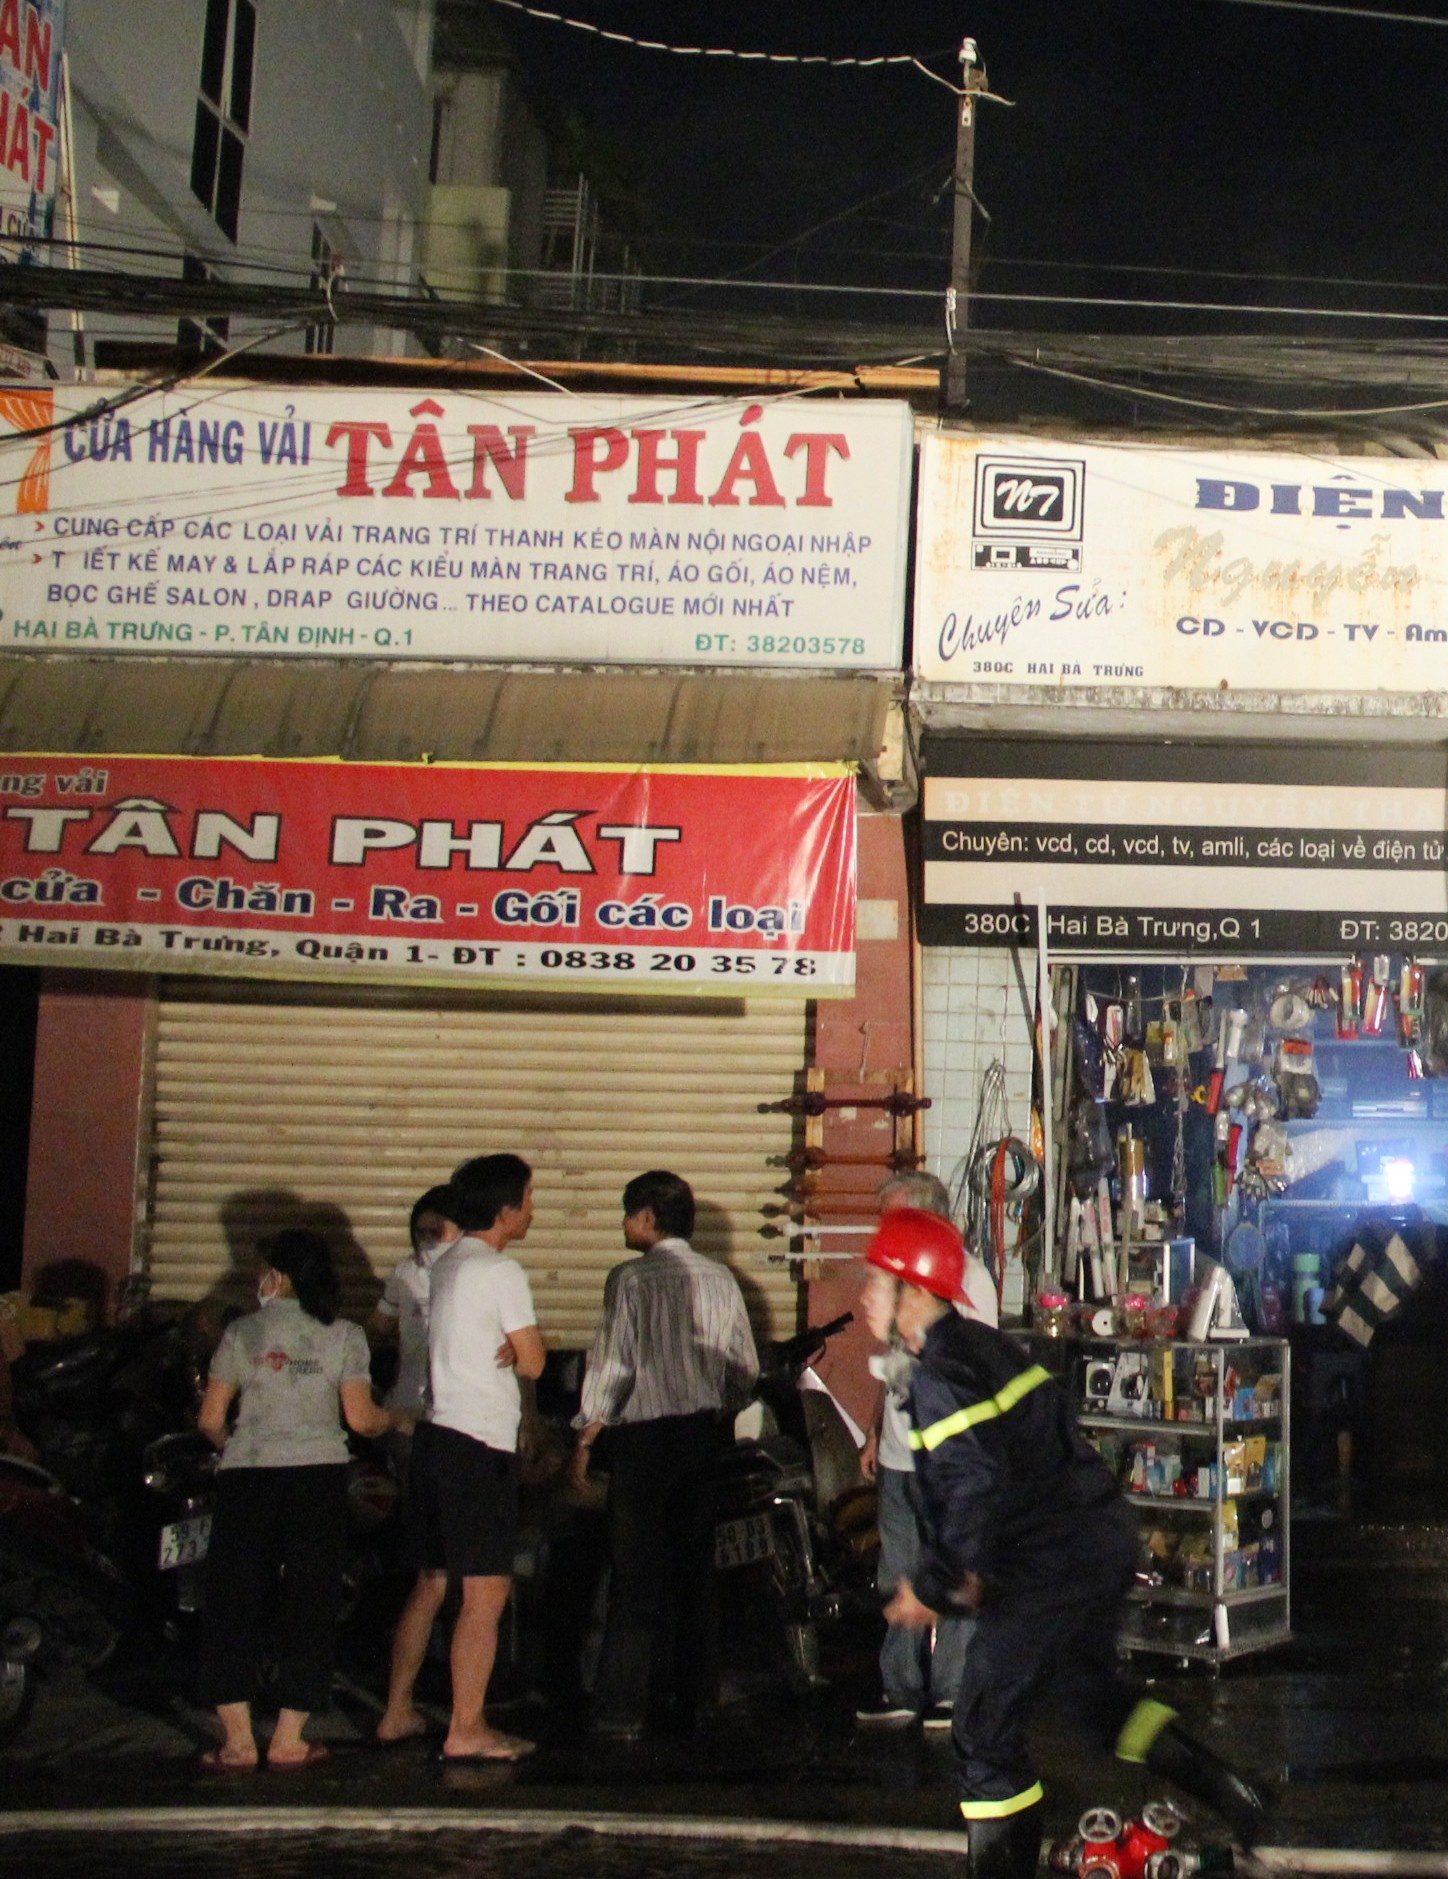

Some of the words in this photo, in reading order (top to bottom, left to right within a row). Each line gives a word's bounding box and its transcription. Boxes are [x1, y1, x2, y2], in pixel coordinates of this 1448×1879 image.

[0, 86, 54, 194] ÁT
[64, 408, 132, 463] CỬA
[148, 408, 246, 466] HÀNG
[259, 404, 311, 466] VẢI
[325, 398, 536, 501] TÂN
[565, 404, 851, 508] PHÁT
[1195, 474, 1444, 530] ĐIỆN
[54, 516, 119, 538] CUNG
[127, 511, 175, 539] CẤP
[184, 514, 231, 540] CÁC
[244, 521, 297, 546] LOẠI
[305, 516, 342, 543] VẢI
[353, 524, 431, 545] TRANG
[441, 521, 478, 546] TRÍ
[488, 527, 564, 548] THANH
[574, 522, 623, 551] KÉO
[629, 525, 680, 551] MÀN
[688, 527, 726, 553] NỘI
[732, 532, 803, 556] NGOẠI
[810, 530, 872, 557] NHẬP
[128, 545, 158, 571] KẾ
[168, 553, 216, 573] MAY
[224, 555, 238, 574] &
[248, 550, 296, 575] LẮP
[303, 552, 350, 577] RÁP
[356, 552, 402, 578] CÁC
[410, 548, 463, 579] KIỂU
[471, 555, 521, 580] MÀN
[529, 562, 608, 582] TRANG
[617, 559, 660, 585] TRÍ,
[668, 558, 699, 583] ÁO
[707, 557, 754, 587] GỐI,
[762, 561, 795, 585] ÁO
[801, 562, 858, 589] NỆM,
[48, 584, 98, 608] BỌC
[107, 579, 158, 604] GHẾ
[166, 587, 247, 609] SALON
[267, 589, 332, 611] DRAP
[467, 594, 528, 613] THEO
[535, 596, 675, 617] CATALOGUE
[683, 593, 724, 617] MỚI
[732, 591, 795, 619] NHẤT
[14, 620, 57, 640] HAI
[66, 616, 99, 641] BÀ
[108, 620, 193, 643] TRƯNG
[215, 625, 236, 644] P.
[242, 621, 289, 645] TÂN
[298, 625, 355, 649] ĐỊNH
[696, 634, 736, 654] ĐT:
[747, 635, 866, 656] 38203578
[938, 595, 1041, 662] Chuyên
[1176, 616, 1226, 636] CD
[1251, 619, 1319, 641] VCD
[1343, 623, 1380, 642] TV
[972, 660, 1013, 675] 380C
[1027, 662, 1055, 675] HAI
[1061, 657, 1082, 676] BÀ
[1093, 661, 1145, 678] TRƯNG
[54, 766, 109, 796] vải
[4, 796, 281, 863] TÂN
[329, 810, 683, 876] PHÁT
[942, 831, 1029, 856] Chuyên:
[1036, 834, 1078, 856] vcd,
[1085, 835, 1116, 856] cd,
[1123, 836, 1165, 857] vcd,
[1172, 837, 1194, 858] tv,
[1201, 837, 1250, 859] amli,
[1257, 837, 1294, 858] các
[1300, 838, 1335, 862] loại
[1342, 834, 1366, 859] về
[1373, 839, 1416, 864] điện
[0, 868, 102, 906] cửa
[177, 877, 315, 918] Chăn
[369, 886, 443, 924] Ra
[493, 888, 581, 928] Gối
[597, 893, 693, 932] các
[708, 895, 806, 940] loại
[964, 913, 1031, 935] 380C
[1047, 915, 1088, 936] Hai
[1096, 915, 1130, 937] Bà
[1250, 919, 1261, 939] 1
[18, 925, 79, 946] Hai
[95, 926, 142, 948] Bà
[160, 930, 280, 958] Trưng,
[296, 938, 389, 964] Quận
[453, 946, 501, 967] ĐT
[540, 949, 636, 971] 0838
[650, 953, 697, 973] 20
[711, 955, 757, 975] 35
[771, 957, 817, 977] 78
[1340, 920, 1380, 941] ĐT:
[1389, 921, 1448, 942] 3820
